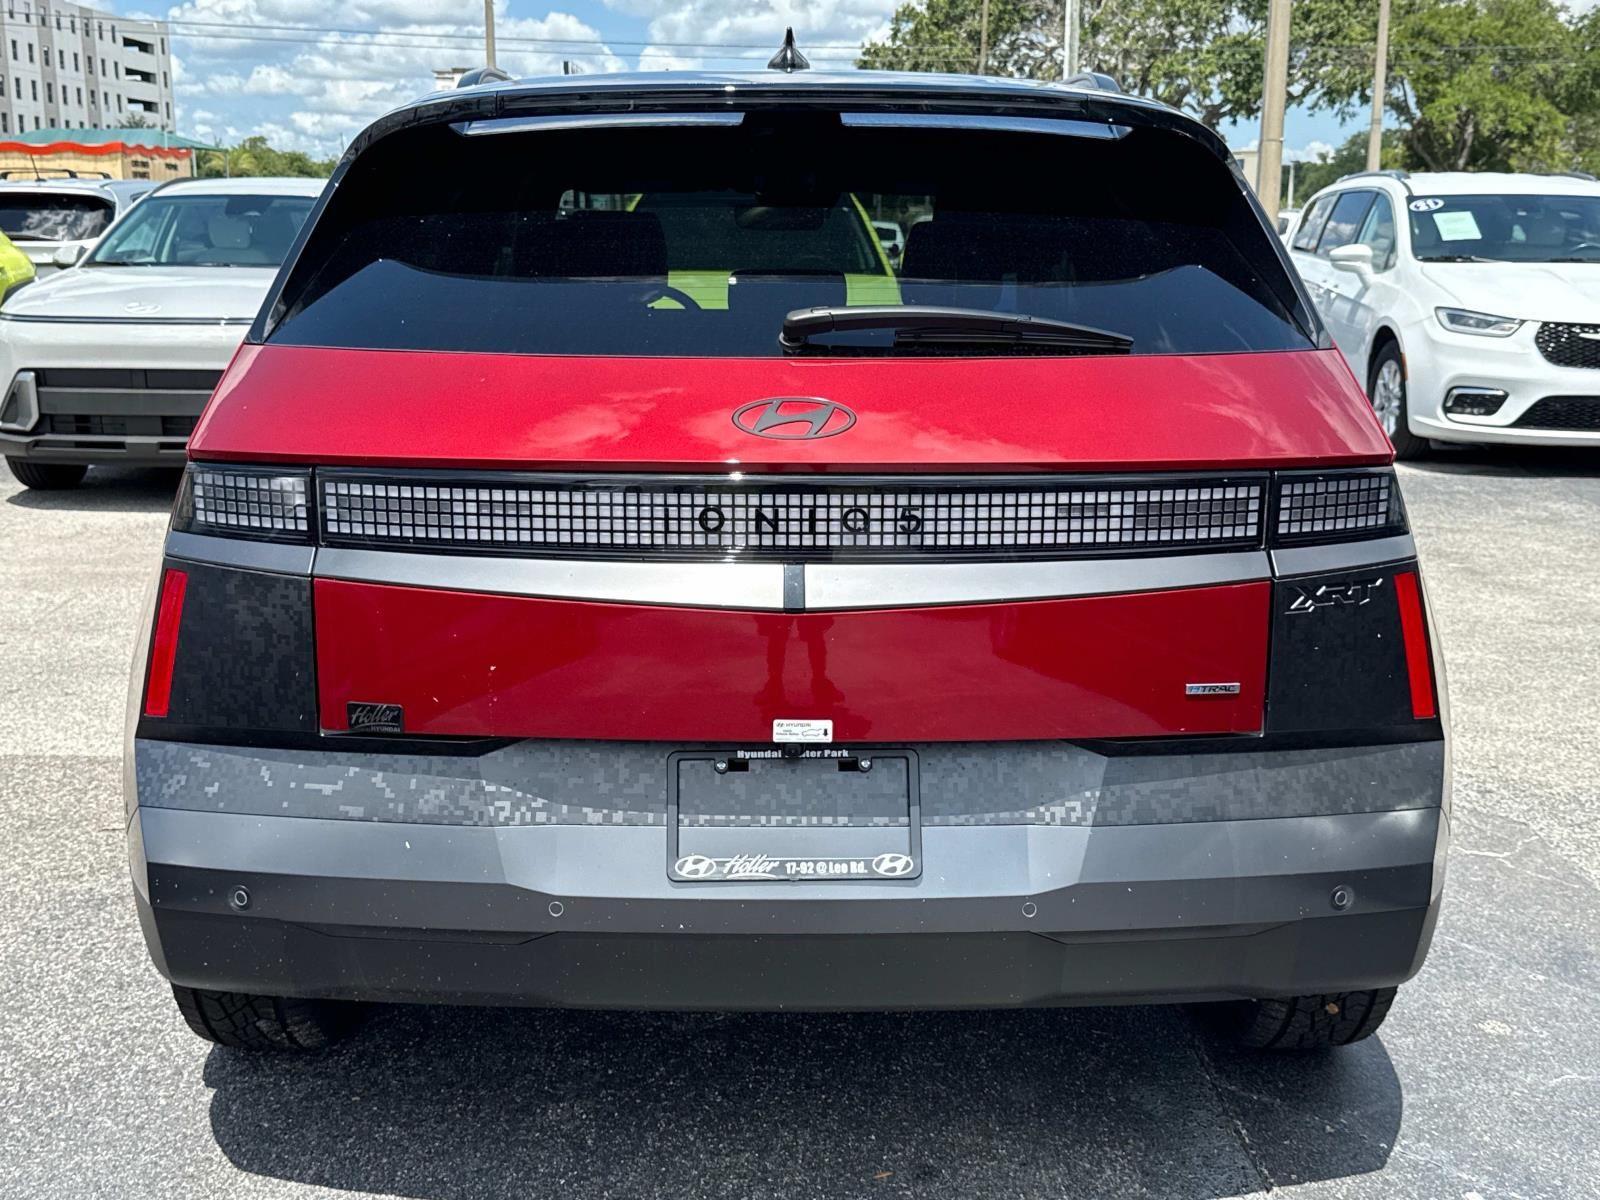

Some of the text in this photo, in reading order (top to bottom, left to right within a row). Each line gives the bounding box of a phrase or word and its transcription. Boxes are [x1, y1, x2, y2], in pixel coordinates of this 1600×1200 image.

[664, 506, 922, 533] IONIQ 5
[1284, 578, 1383, 614] XRT
[351, 704, 399, 724] Holler
[737, 750, 782, 759] Hyundai
[723, 853, 780, 875] Holler
[785, 862, 814, 874] 17-92
[816, 861, 827, 874] @
[850, 861, 868, 873] Rd.
